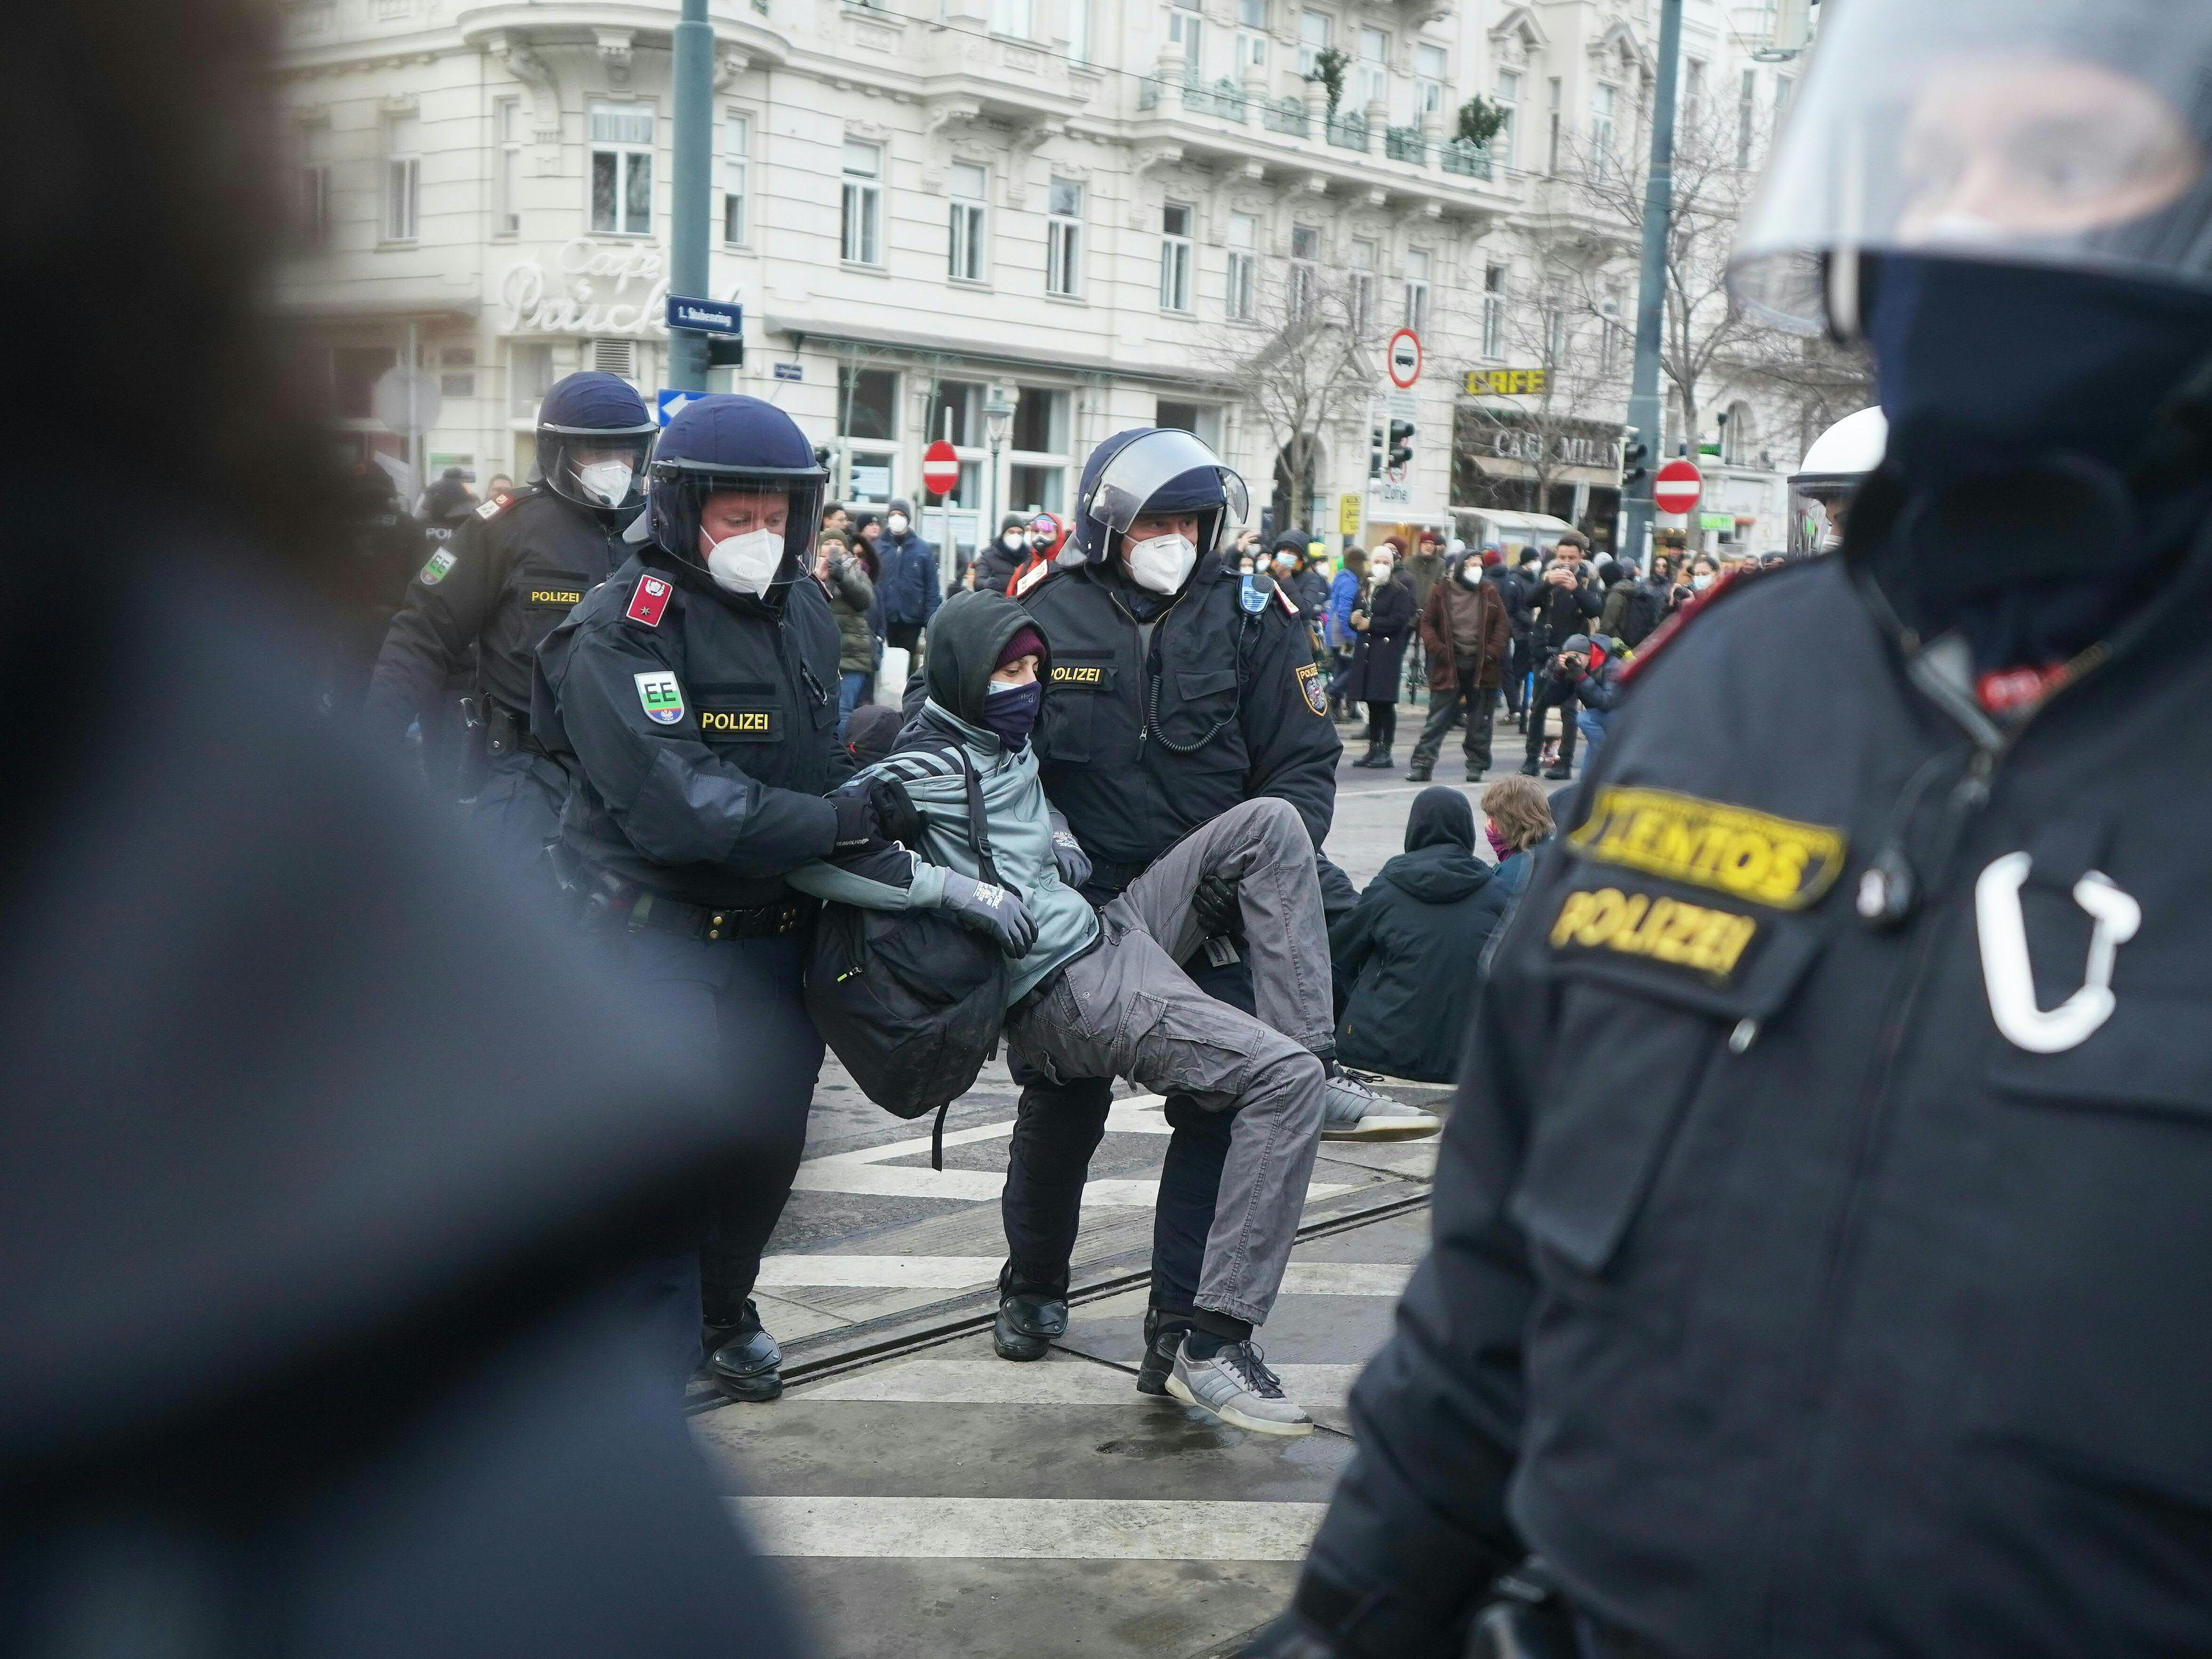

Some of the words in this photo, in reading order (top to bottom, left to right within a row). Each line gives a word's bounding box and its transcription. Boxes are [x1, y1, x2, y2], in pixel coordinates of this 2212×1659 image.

[1467, 370, 1546, 394] CAFE
[531, 590, 579, 603] POLIZEI
[644, 682, 677, 703] EE
[702, 712, 768, 731] POLIZEI
[1551, 887, 1757, 972] POLIZEI
